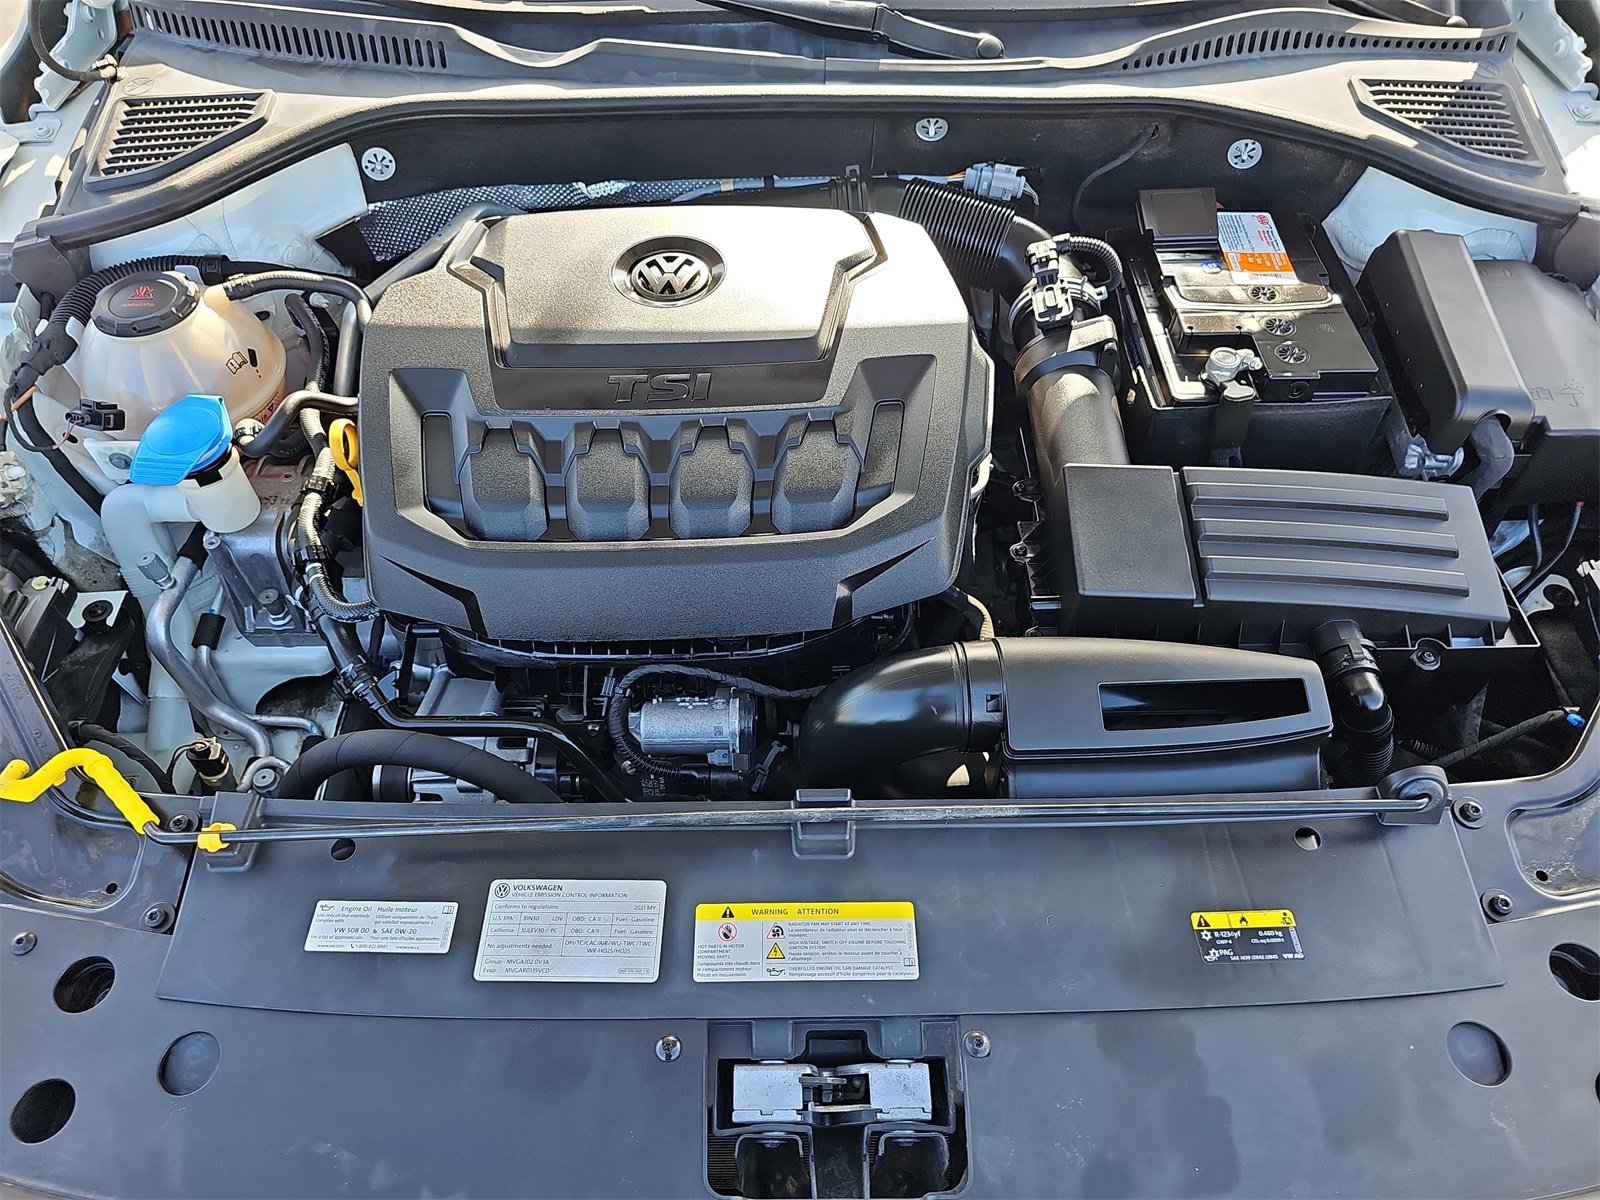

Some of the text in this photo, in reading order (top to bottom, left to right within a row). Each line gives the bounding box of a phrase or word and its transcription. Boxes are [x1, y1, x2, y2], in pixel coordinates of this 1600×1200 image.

[606, 372, 712, 403] TSI
[341, 905, 362, 913] Engine
[751, 907, 839, 916] WARNING ATTENTION
[1219, 948, 1234, 957] PAG
